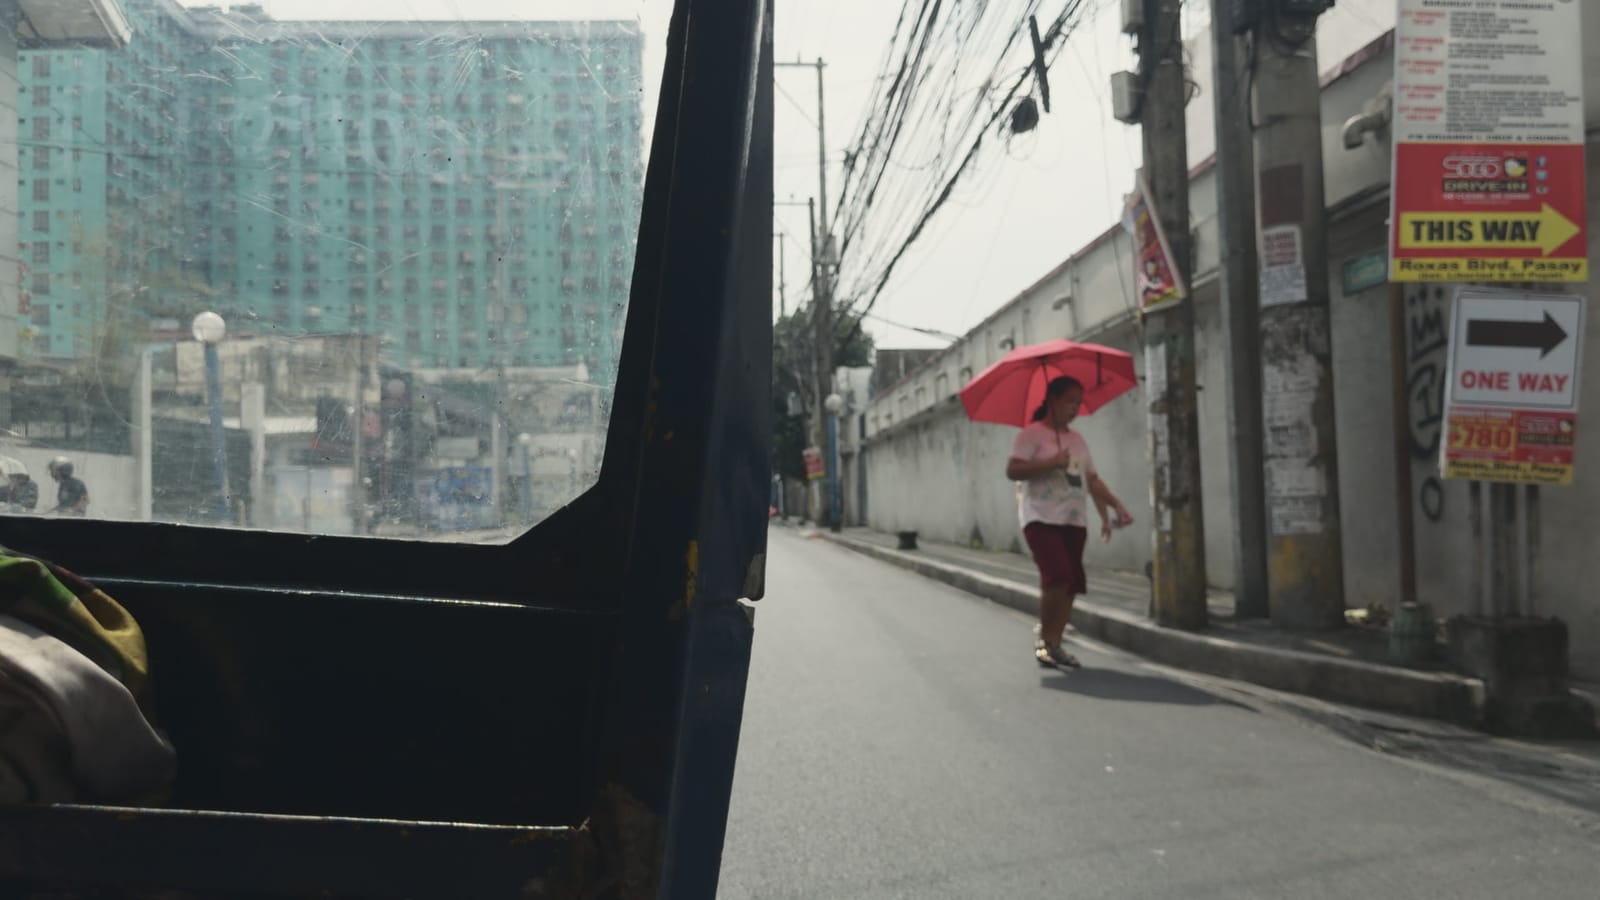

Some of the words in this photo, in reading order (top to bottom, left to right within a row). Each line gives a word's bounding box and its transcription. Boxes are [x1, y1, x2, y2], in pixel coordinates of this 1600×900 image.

[1411, 219, 1473, 242] THIS
[1480, 219, 1541, 242] WAY
[1400, 260, 1459, 271] Roxas
[1522, 261, 1581, 273] Pasay
[1460, 370, 1510, 391] ONE
[1518, 373, 1569, 393] WAY
